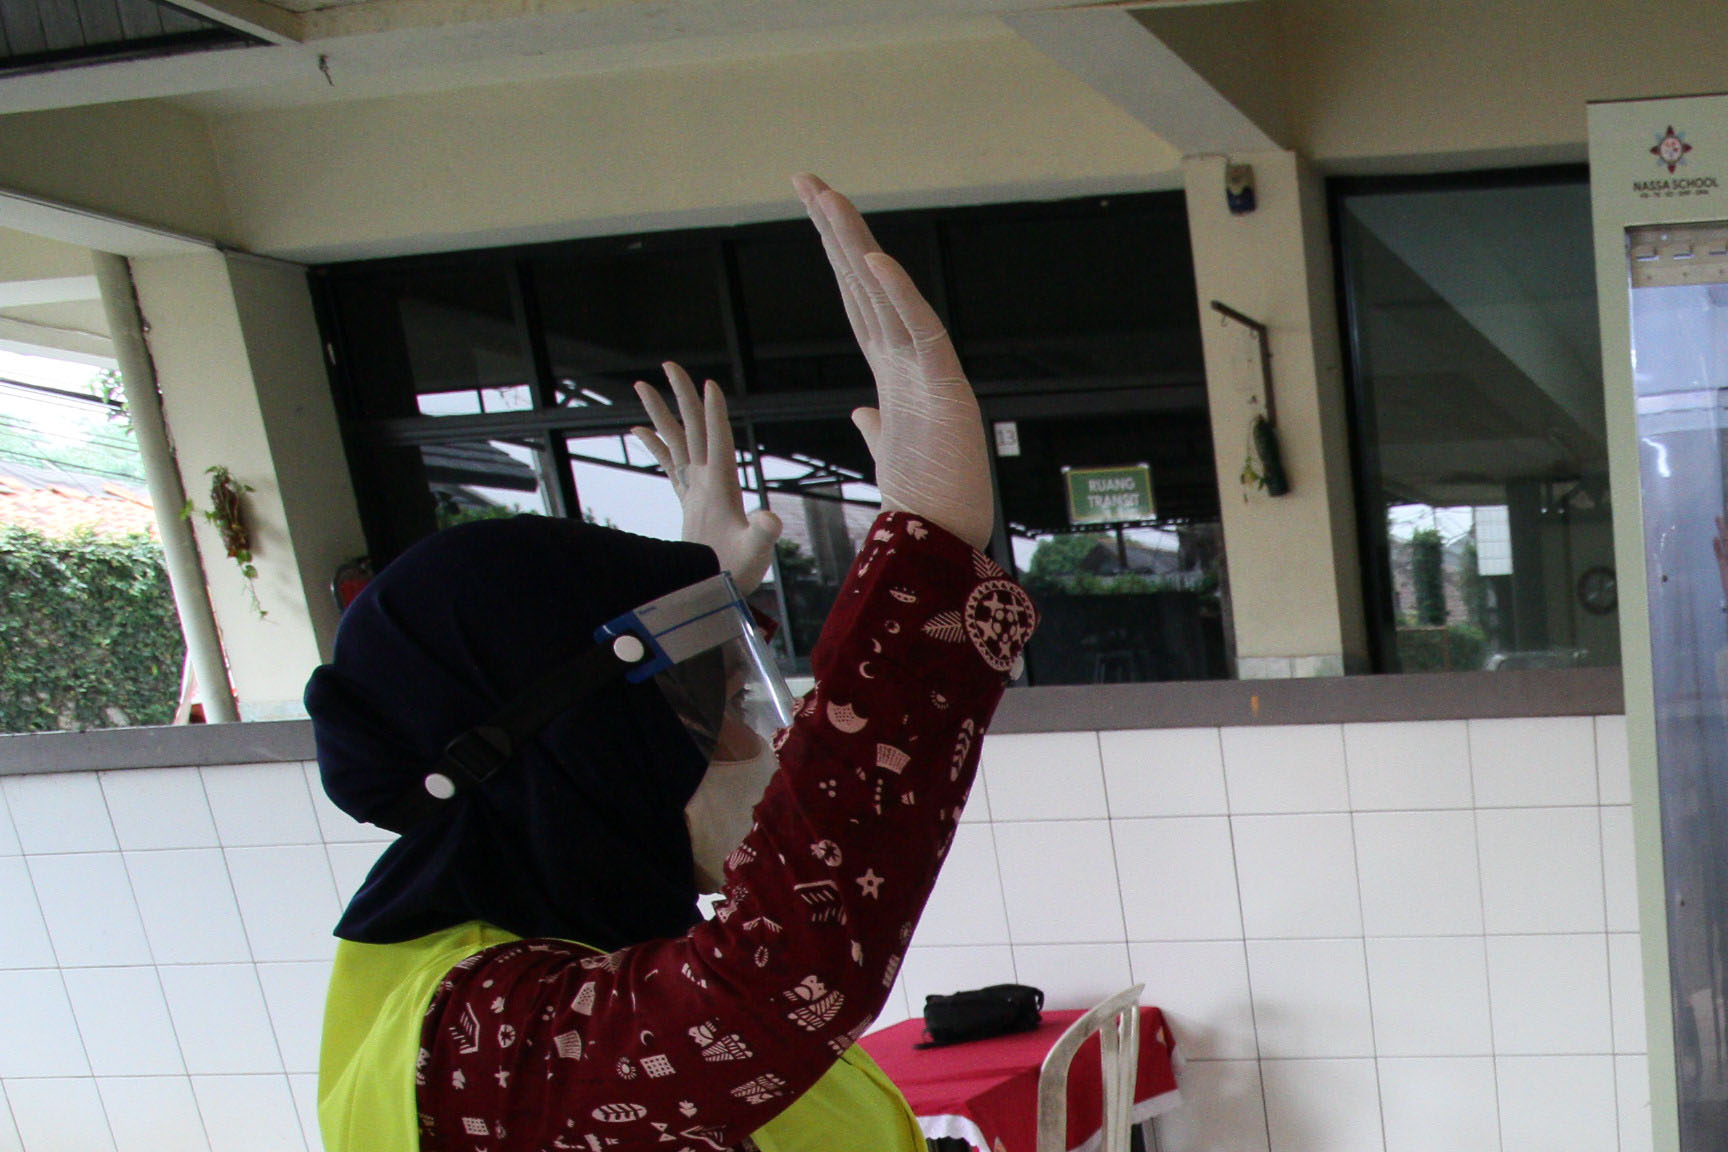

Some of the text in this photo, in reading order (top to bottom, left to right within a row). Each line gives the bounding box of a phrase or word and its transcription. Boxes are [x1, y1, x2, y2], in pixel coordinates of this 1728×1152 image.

[1632, 176, 1719, 192] NASSA SCHOOL
[1088, 476, 1136, 492] RUANG
[1087, 492, 1140, 509] TRANSIT
